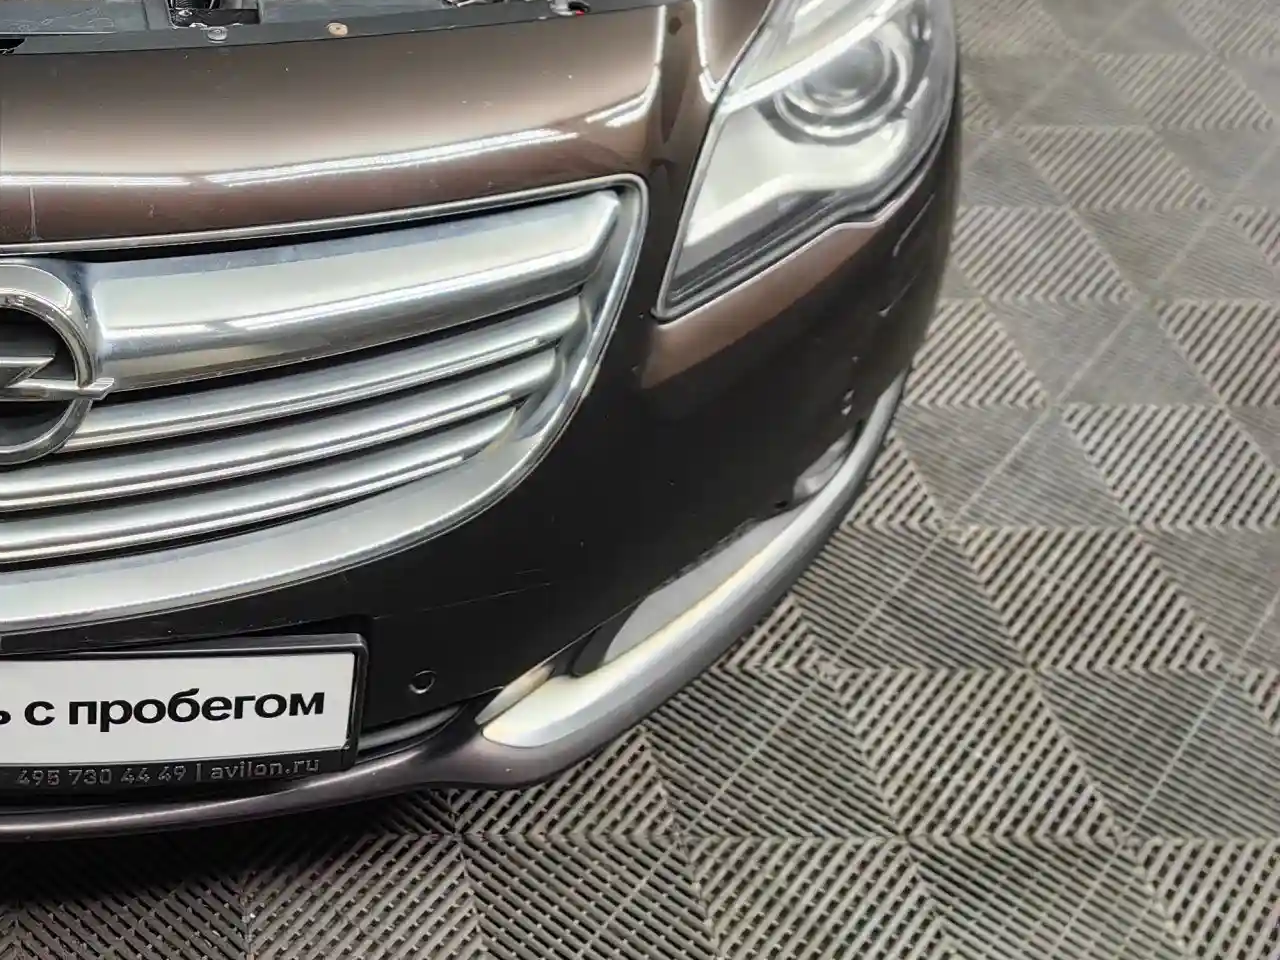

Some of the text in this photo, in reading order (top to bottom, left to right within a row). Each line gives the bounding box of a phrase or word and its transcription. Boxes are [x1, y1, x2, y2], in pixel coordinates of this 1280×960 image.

[24, 700, 55, 726] с
[68, 687, 325, 733] пробегом
[17, 768, 61, 786] 495
[68, 768, 113, 786] 730
[120, 766, 151, 784] 44
[157, 765, 188, 784] 49
[211, 757, 321, 782] avilon.ru
